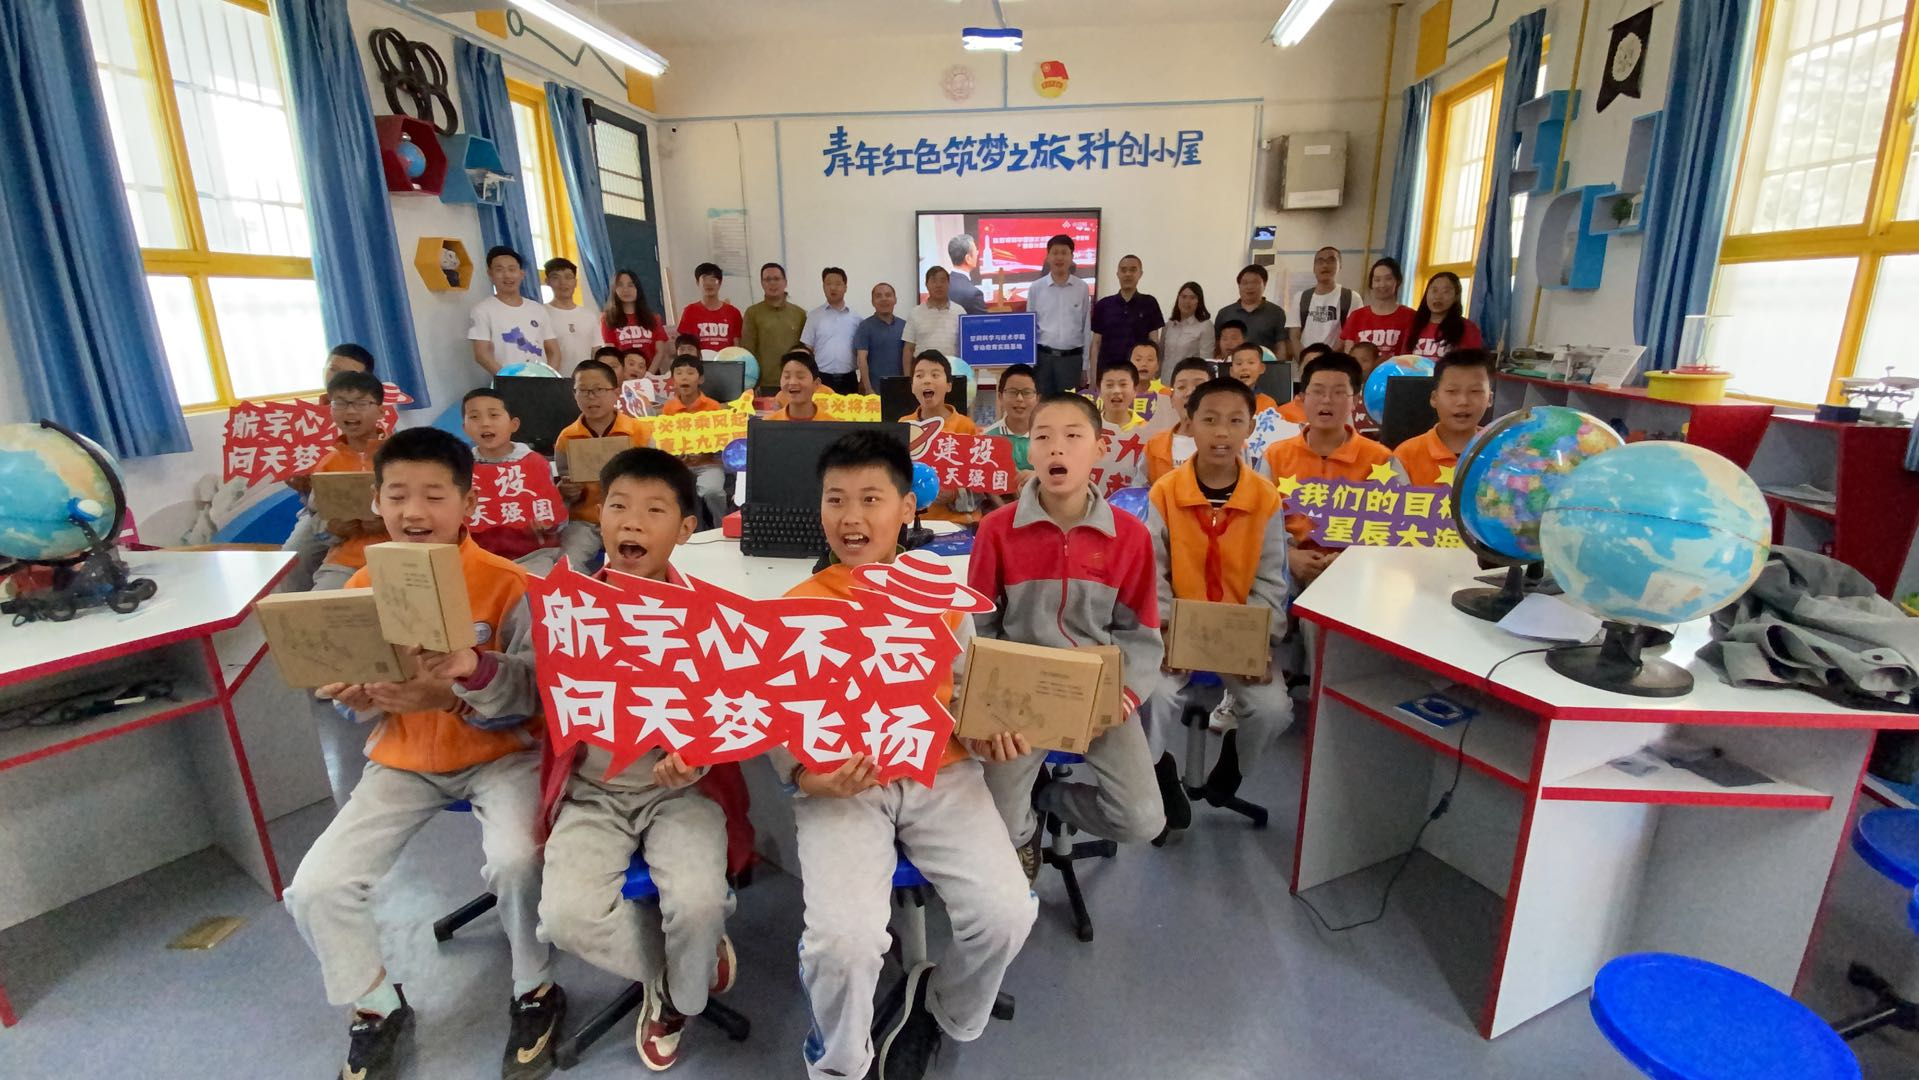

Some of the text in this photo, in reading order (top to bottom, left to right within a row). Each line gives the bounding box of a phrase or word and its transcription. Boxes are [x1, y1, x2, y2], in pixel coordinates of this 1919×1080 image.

[616, 325, 653, 340] XDU
[697, 322, 729, 337] XDU
[1358, 329, 1401, 346] XDU
[653, 413, 747, 433] 必将乘风起
[228, 444, 338, 475] 问天梦
[933, 435, 999, 468] 建设
[931, 466, 1009, 492] 天强国
[541, 587, 937, 685] 航宇心不忘
[549, 672, 936, 771] 问天梦飞扬
